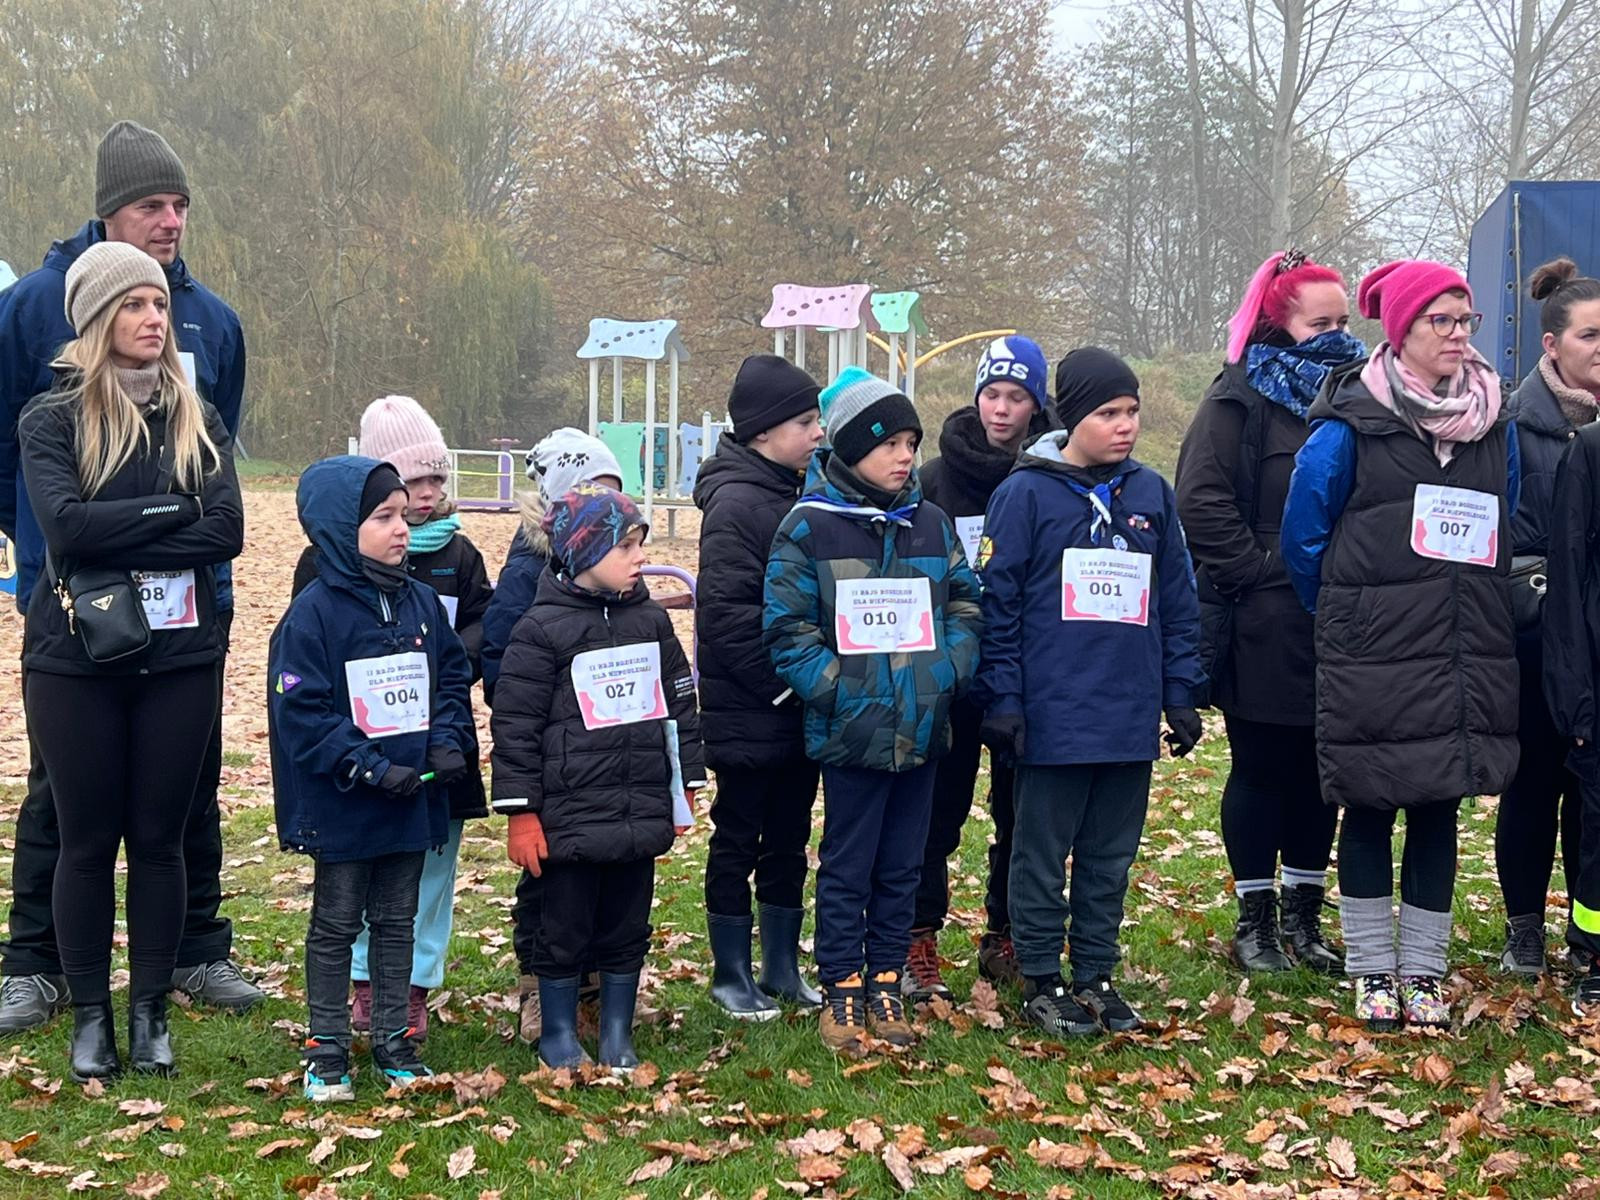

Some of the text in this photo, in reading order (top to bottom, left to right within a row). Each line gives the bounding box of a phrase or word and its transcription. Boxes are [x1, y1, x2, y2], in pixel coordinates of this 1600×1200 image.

[1440, 521, 1471, 537] 007
[1089, 582, 1123, 597] 001
[863, 611, 897, 626] 010
[384, 688, 419, 706] 004
[605, 682, 636, 699] 027
